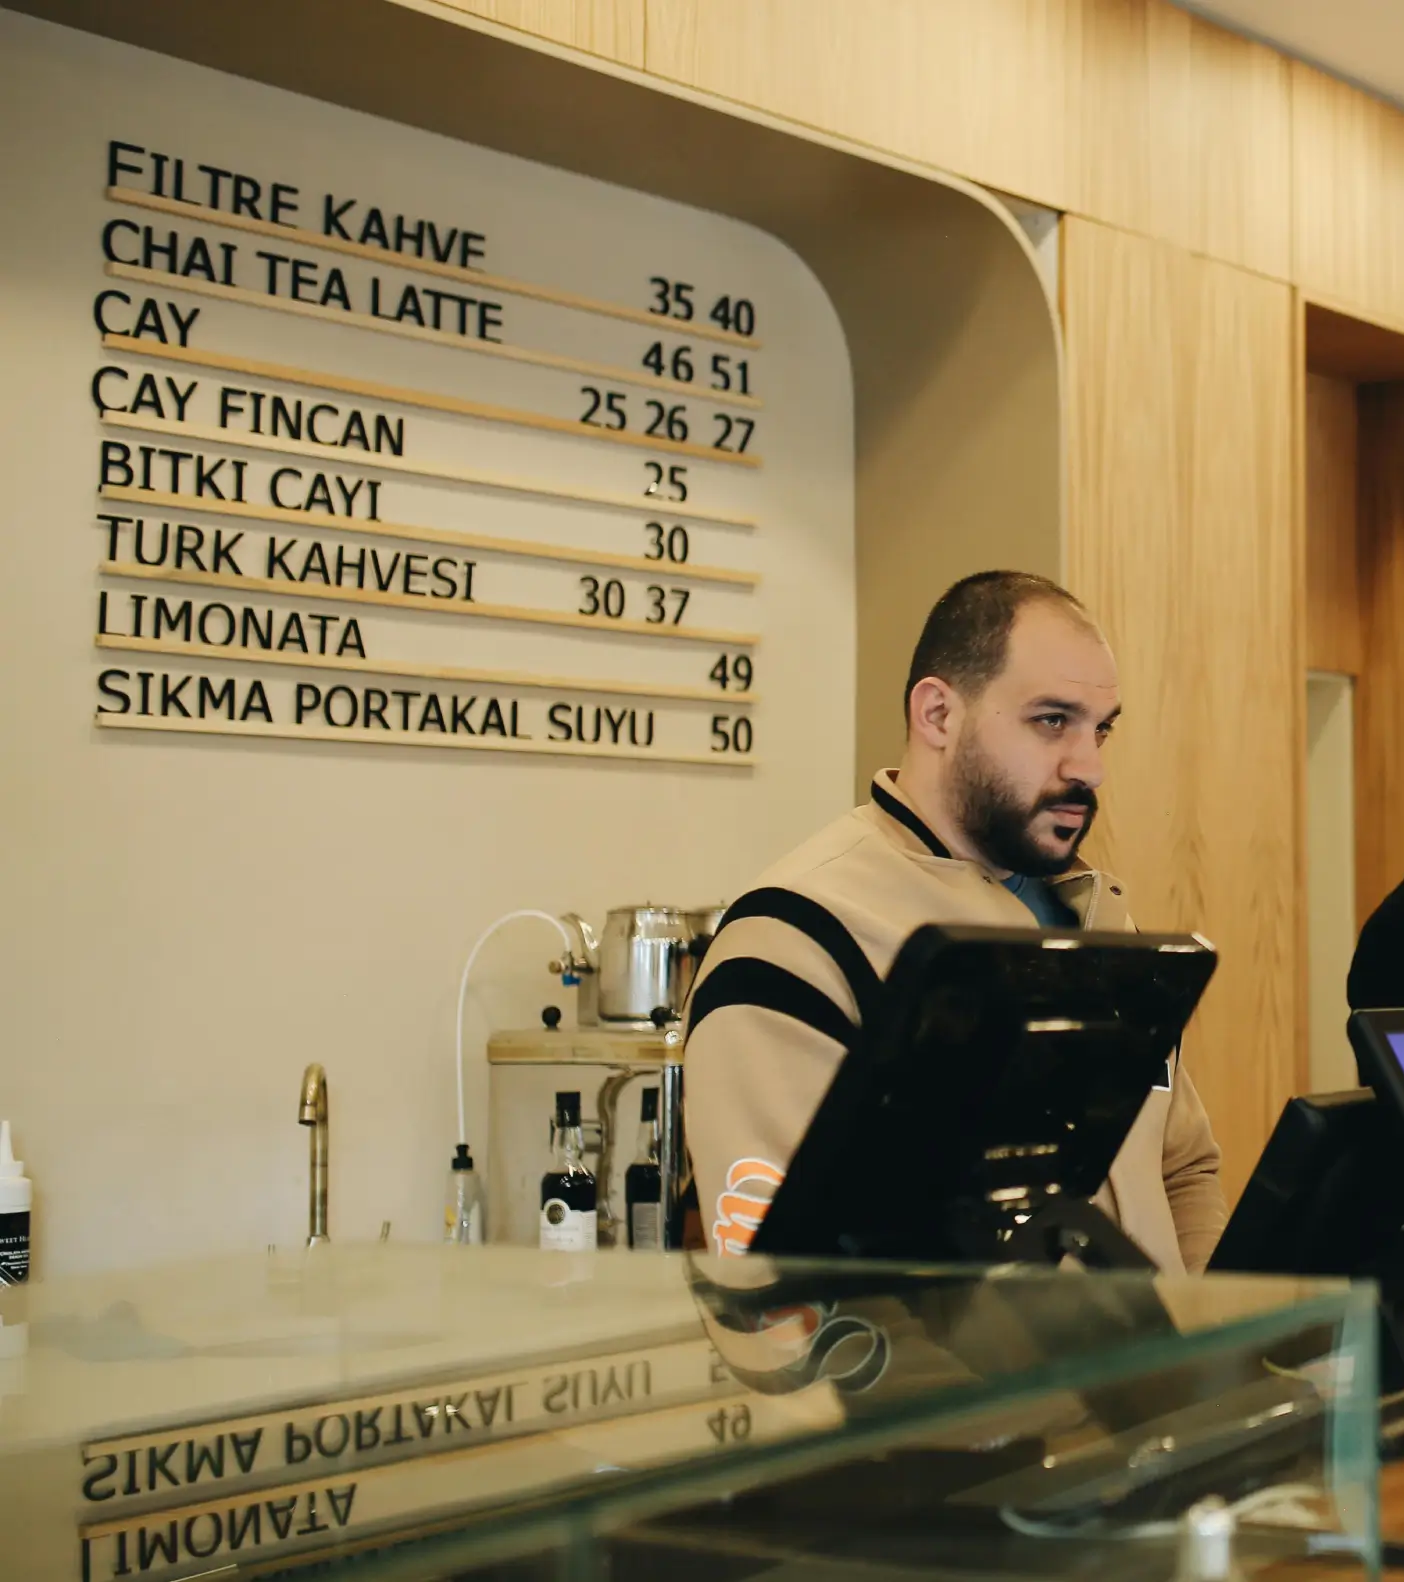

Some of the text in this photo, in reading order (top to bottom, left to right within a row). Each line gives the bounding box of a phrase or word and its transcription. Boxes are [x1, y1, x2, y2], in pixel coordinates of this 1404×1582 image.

[109, 140, 756, 337] FILTRE KAHVE 35 40
[92, 289, 756, 453] CAY 25 26 27
[101, 218, 751, 395] CHAI TEA LATTE 46 51
[91, 366, 688, 502] CAY FINCAN 25
[100, 440, 690, 564] BITKI CAYI 30
[96, 514, 691, 627] TURK KAHVESI 30 37
[98, 590, 754, 692] LIMONATA 49
[97, 668, 754, 753] SIKMA PORTAKAL SUYU 50
